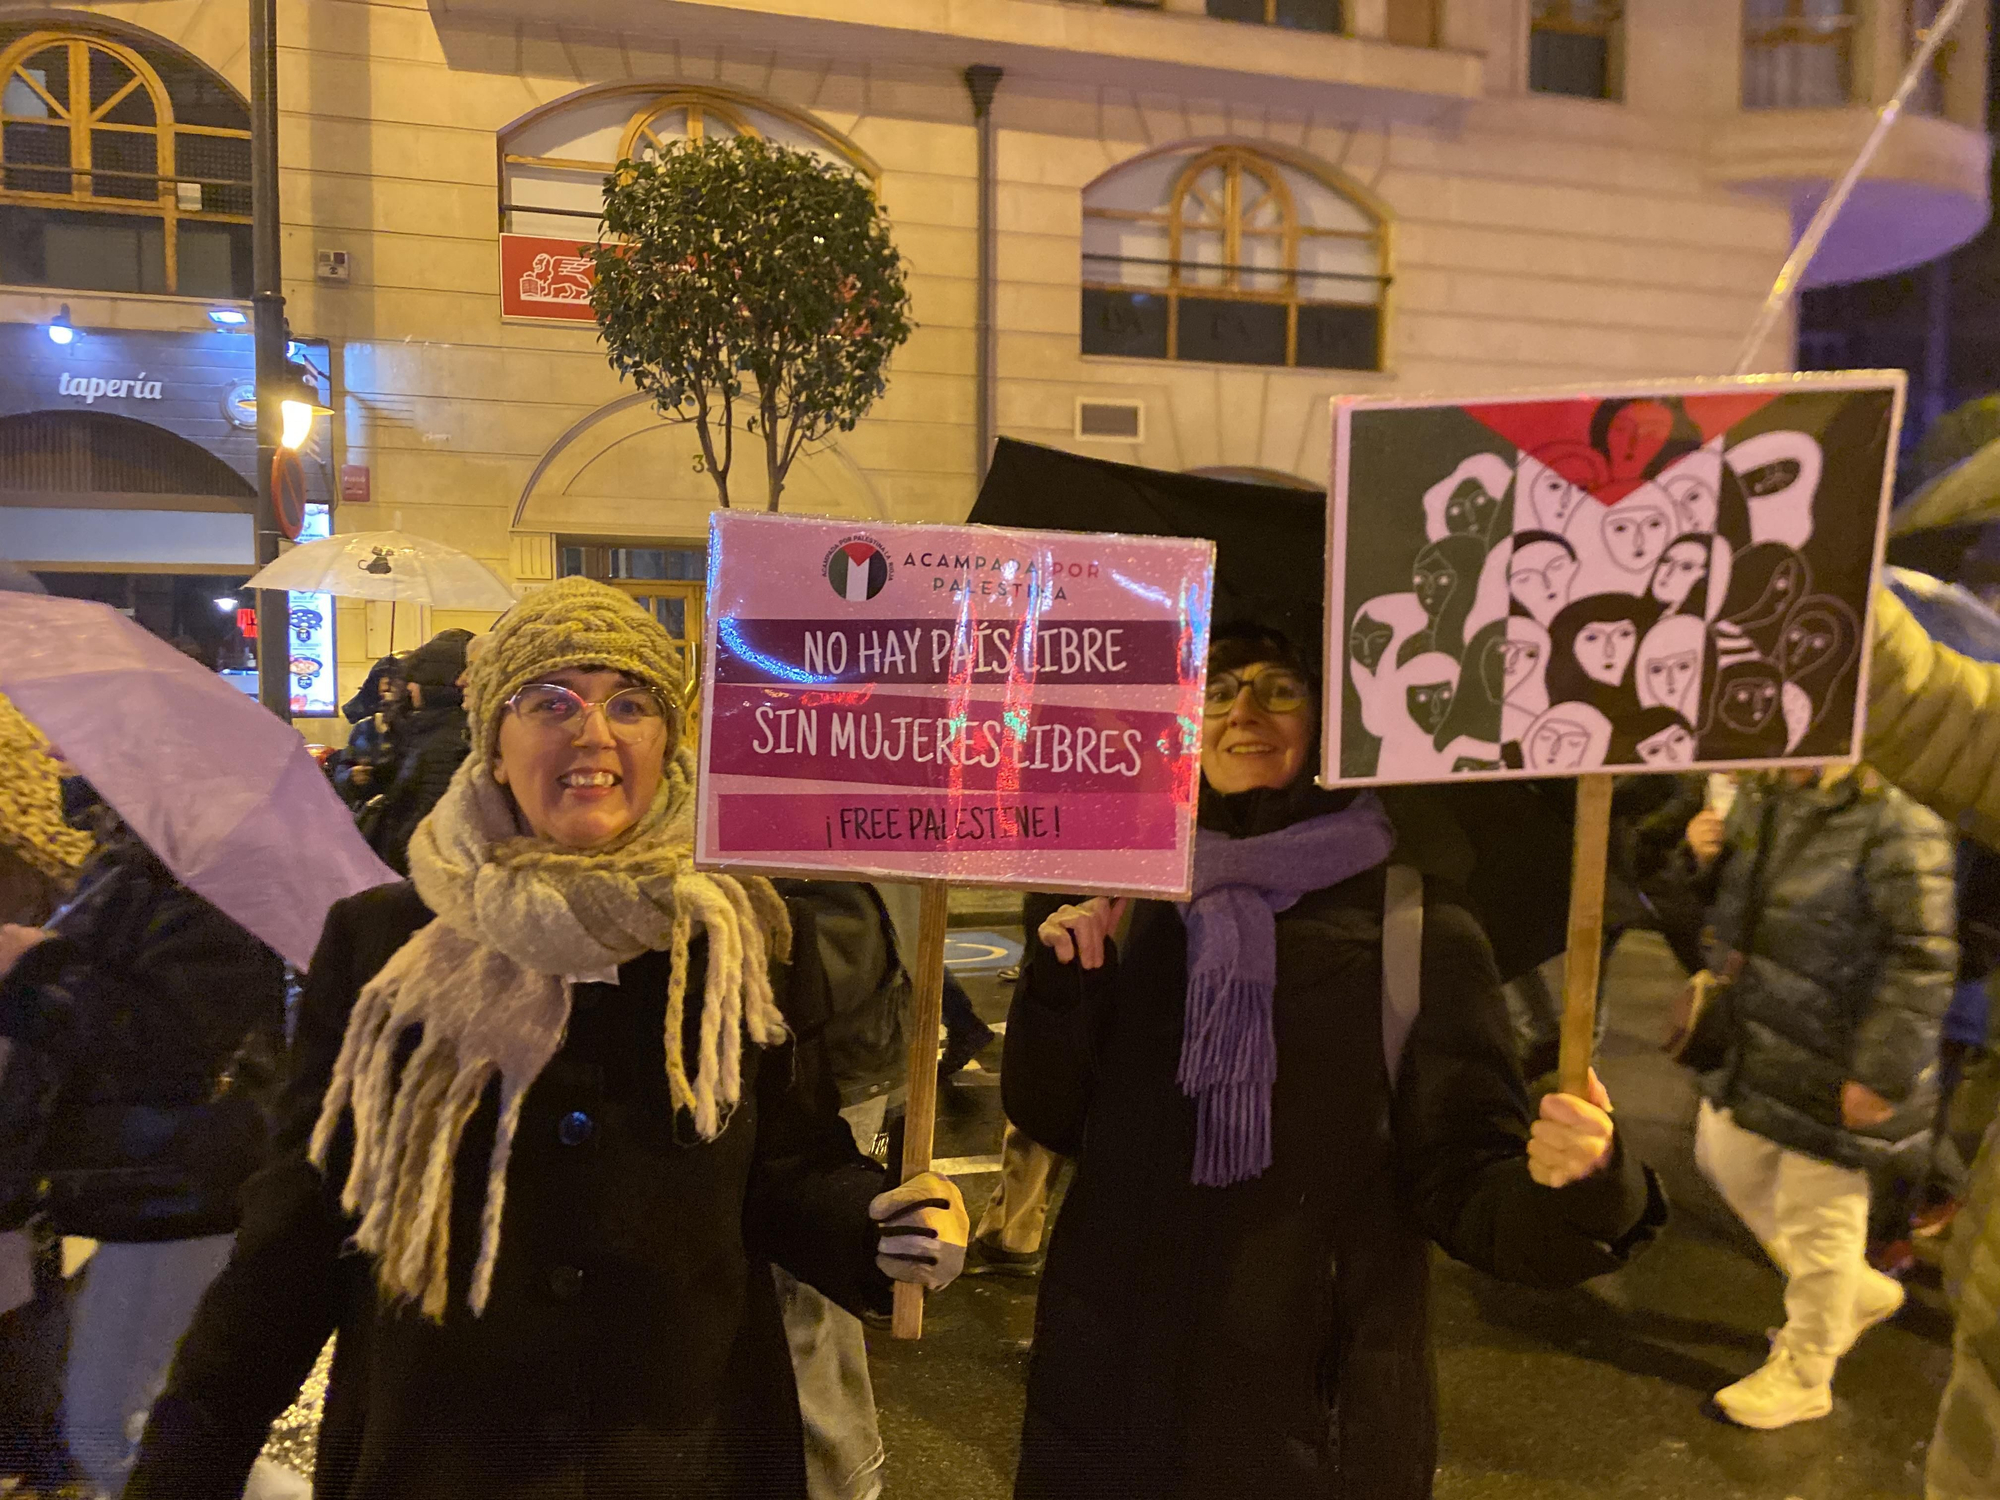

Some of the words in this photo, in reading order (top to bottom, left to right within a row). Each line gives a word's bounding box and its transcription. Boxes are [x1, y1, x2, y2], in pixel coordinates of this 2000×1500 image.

[59, 372, 162, 404] tapería
[1052, 562, 1099, 579] POR
[804, 630, 848, 675] NO
[858, 627, 922, 675] HAY
[931, 621, 1011, 674] PAÍS
[1023, 626, 1127, 675] LIBRE
[753, 706, 818, 756] SIN
[830, 711, 1000, 769] MUJERES
[1014, 723, 1142, 777] LIBRES
